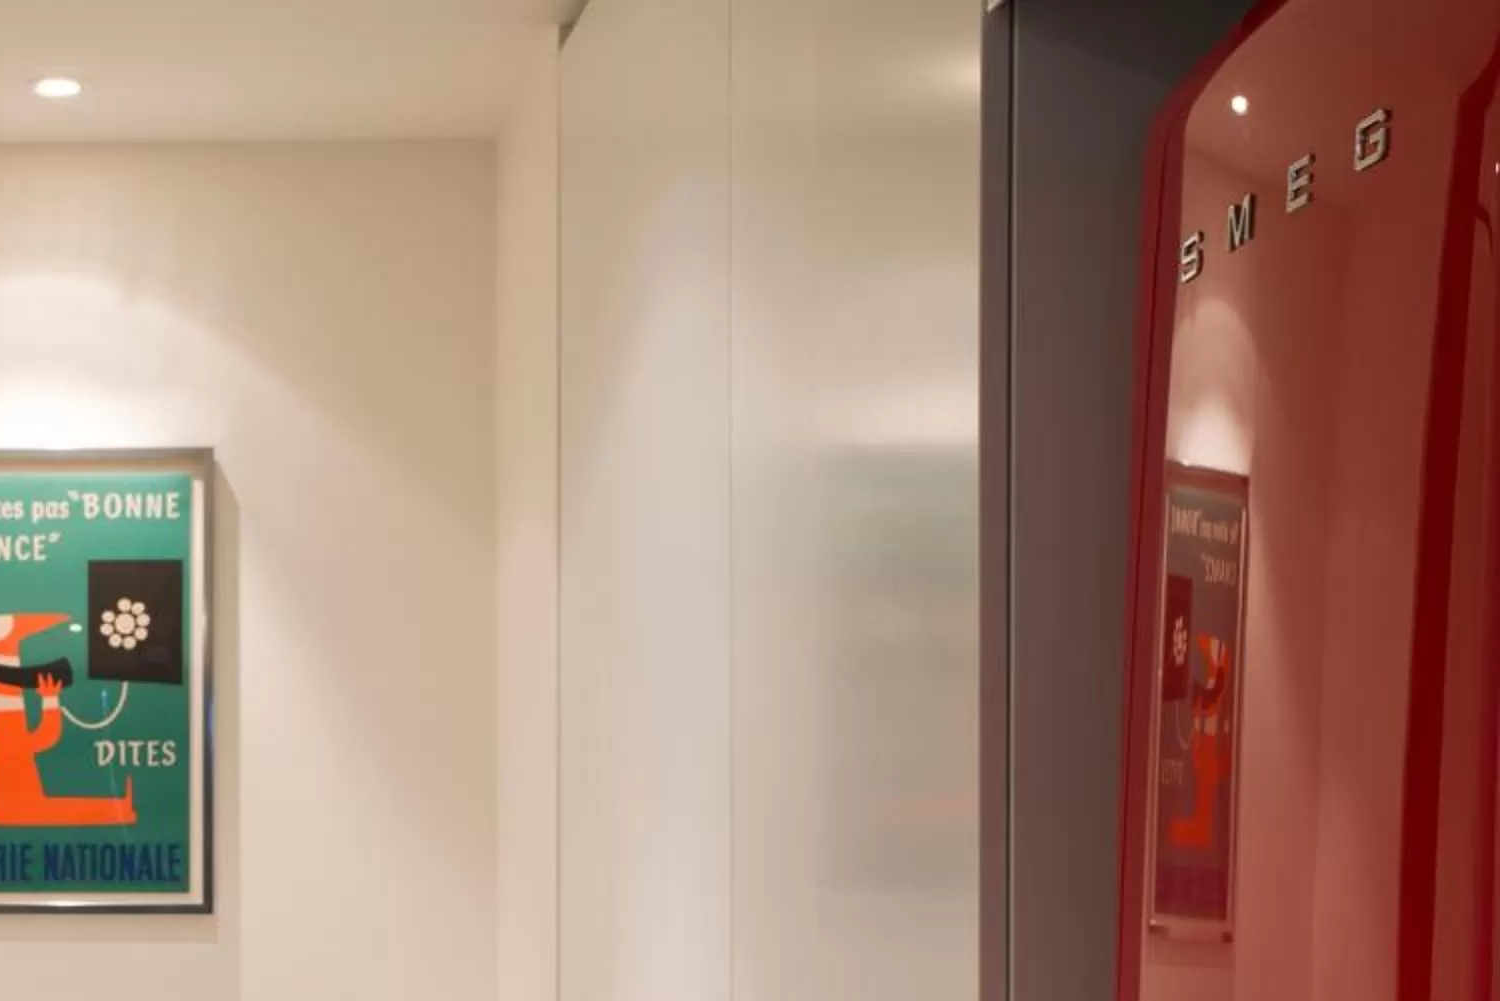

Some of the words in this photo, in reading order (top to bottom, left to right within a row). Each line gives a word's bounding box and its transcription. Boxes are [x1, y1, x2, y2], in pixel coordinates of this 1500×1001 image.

[1180, 107, 1392, 284] SMEG
[31, 500, 69, 524] pas
[93, 740, 177, 767] DITES
[43, 843, 181, 882] NATIONALE
